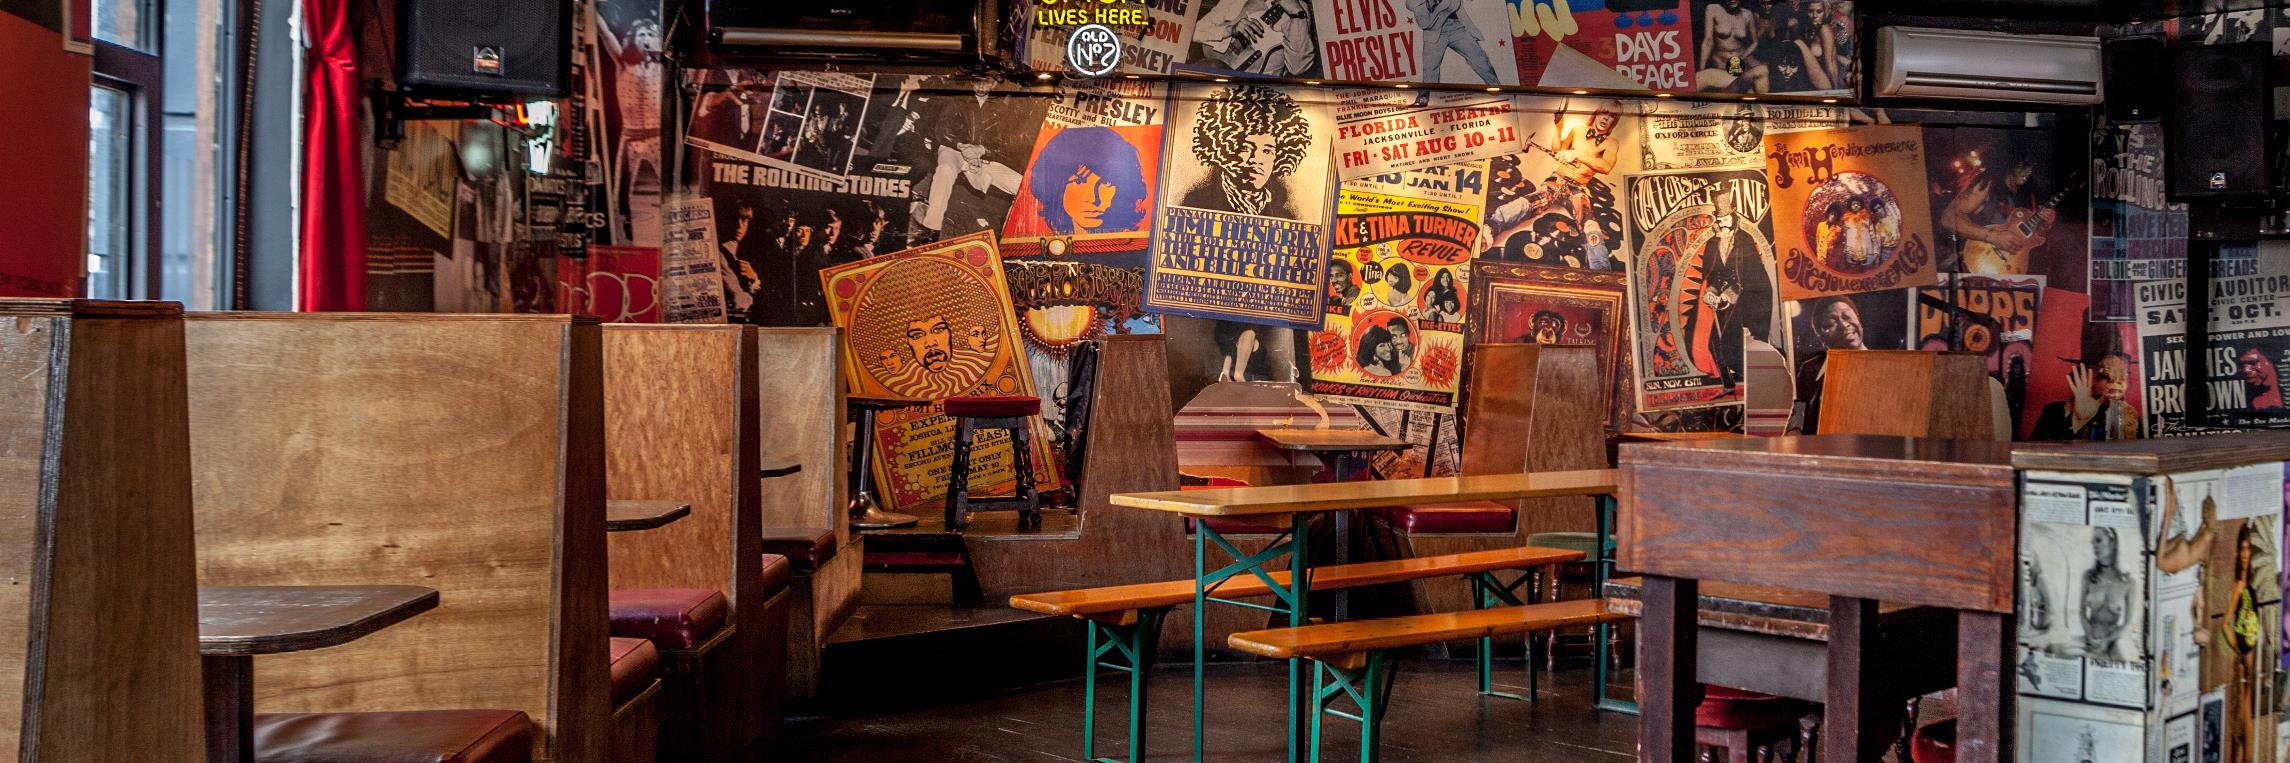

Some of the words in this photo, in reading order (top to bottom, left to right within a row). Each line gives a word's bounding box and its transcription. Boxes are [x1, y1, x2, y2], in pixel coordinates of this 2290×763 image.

[1038, 9, 1088, 25] LIVES
[1332, 0, 1397, 34] ELVIS
[1081, 31, 1108, 42] OLD
[1615, 31, 1681, 62] DAYS
[1326, 31, 1417, 81] PRESLEY
[1049, 103, 1080, 117] SCOTTY
[1073, 91, 1158, 125] PRESLEY
[1338, 116, 1419, 140] FLORIDA
[1430, 104, 1511, 125] THEATRE
[1363, 128, 1435, 146] JACKSONVILLE
[1450, 119, 1491, 132] FLORIDA
[1343, 149, 1370, 168] FRI
[1381, 143, 1409, 162] SAT
[1415, 135, 1457, 156] AUG
[2114, 152, 2156, 173] THE
[712, 162, 749, 185] THE
[753, 166, 834, 193] ROLLING
[836, 174, 912, 199] STONES
[1454, 168, 1484, 195] 14
[1350, 193, 1381, 204] World's
[1383, 197, 1405, 206] Most
[1407, 200, 1441, 214] Exciting
[1335, 216, 1360, 246] KE
[1366, 214, 1411, 241] TINA
[1412, 214, 1477, 249] TURNER
[1402, 239, 1463, 262] REVUE
[2092, 260, 2131, 279] GOLDIE
[2140, 283, 2185, 302] CIVIC
[2228, 302, 2281, 320] OCT.
[1420, 320, 1463, 332] IKE-ETTES
[2208, 332, 2245, 342] POWER
[2247, 330, 2269, 339] AND
[1312, 381, 1344, 396] KINGS
[1357, 385, 1398, 400] RHYTHM
[1664, 379, 1683, 389] NOV.
[909, 429, 943, 442] JOSHUA
[976, 427, 1010, 444] EAST
[904, 459, 932, 470] SECOND
[927, 466, 947, 477] ONE
[979, 451, 1002, 463] ONLY
[968, 463, 988, 475] MAY
